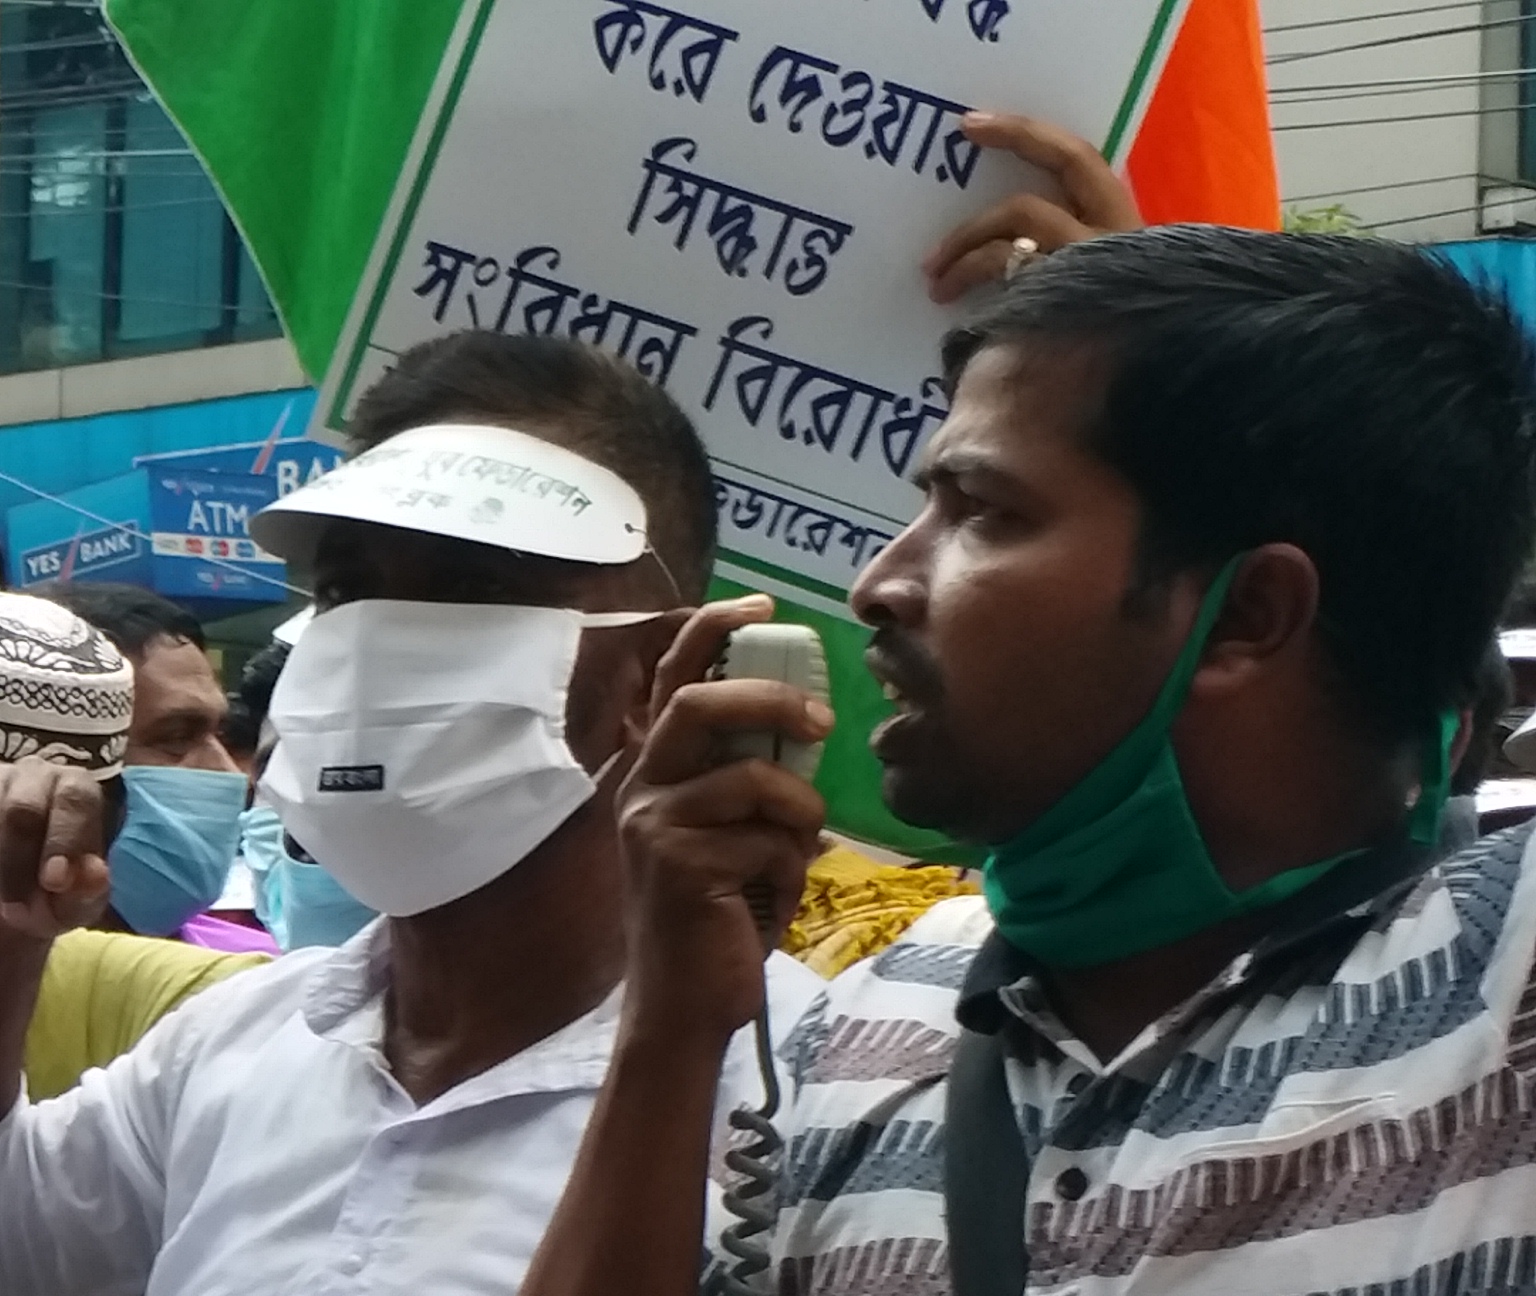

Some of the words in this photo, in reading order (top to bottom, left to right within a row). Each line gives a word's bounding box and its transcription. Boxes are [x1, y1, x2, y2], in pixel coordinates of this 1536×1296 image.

[592, 0, 739, 103] করে
[627, 137, 854, 296] সিদ্ধান্ত
[278, 456, 344, 497] BA
[188, 500, 250, 535] ATM
[27, 551, 61, 578] YES
[80, 530, 131, 563] BANK
